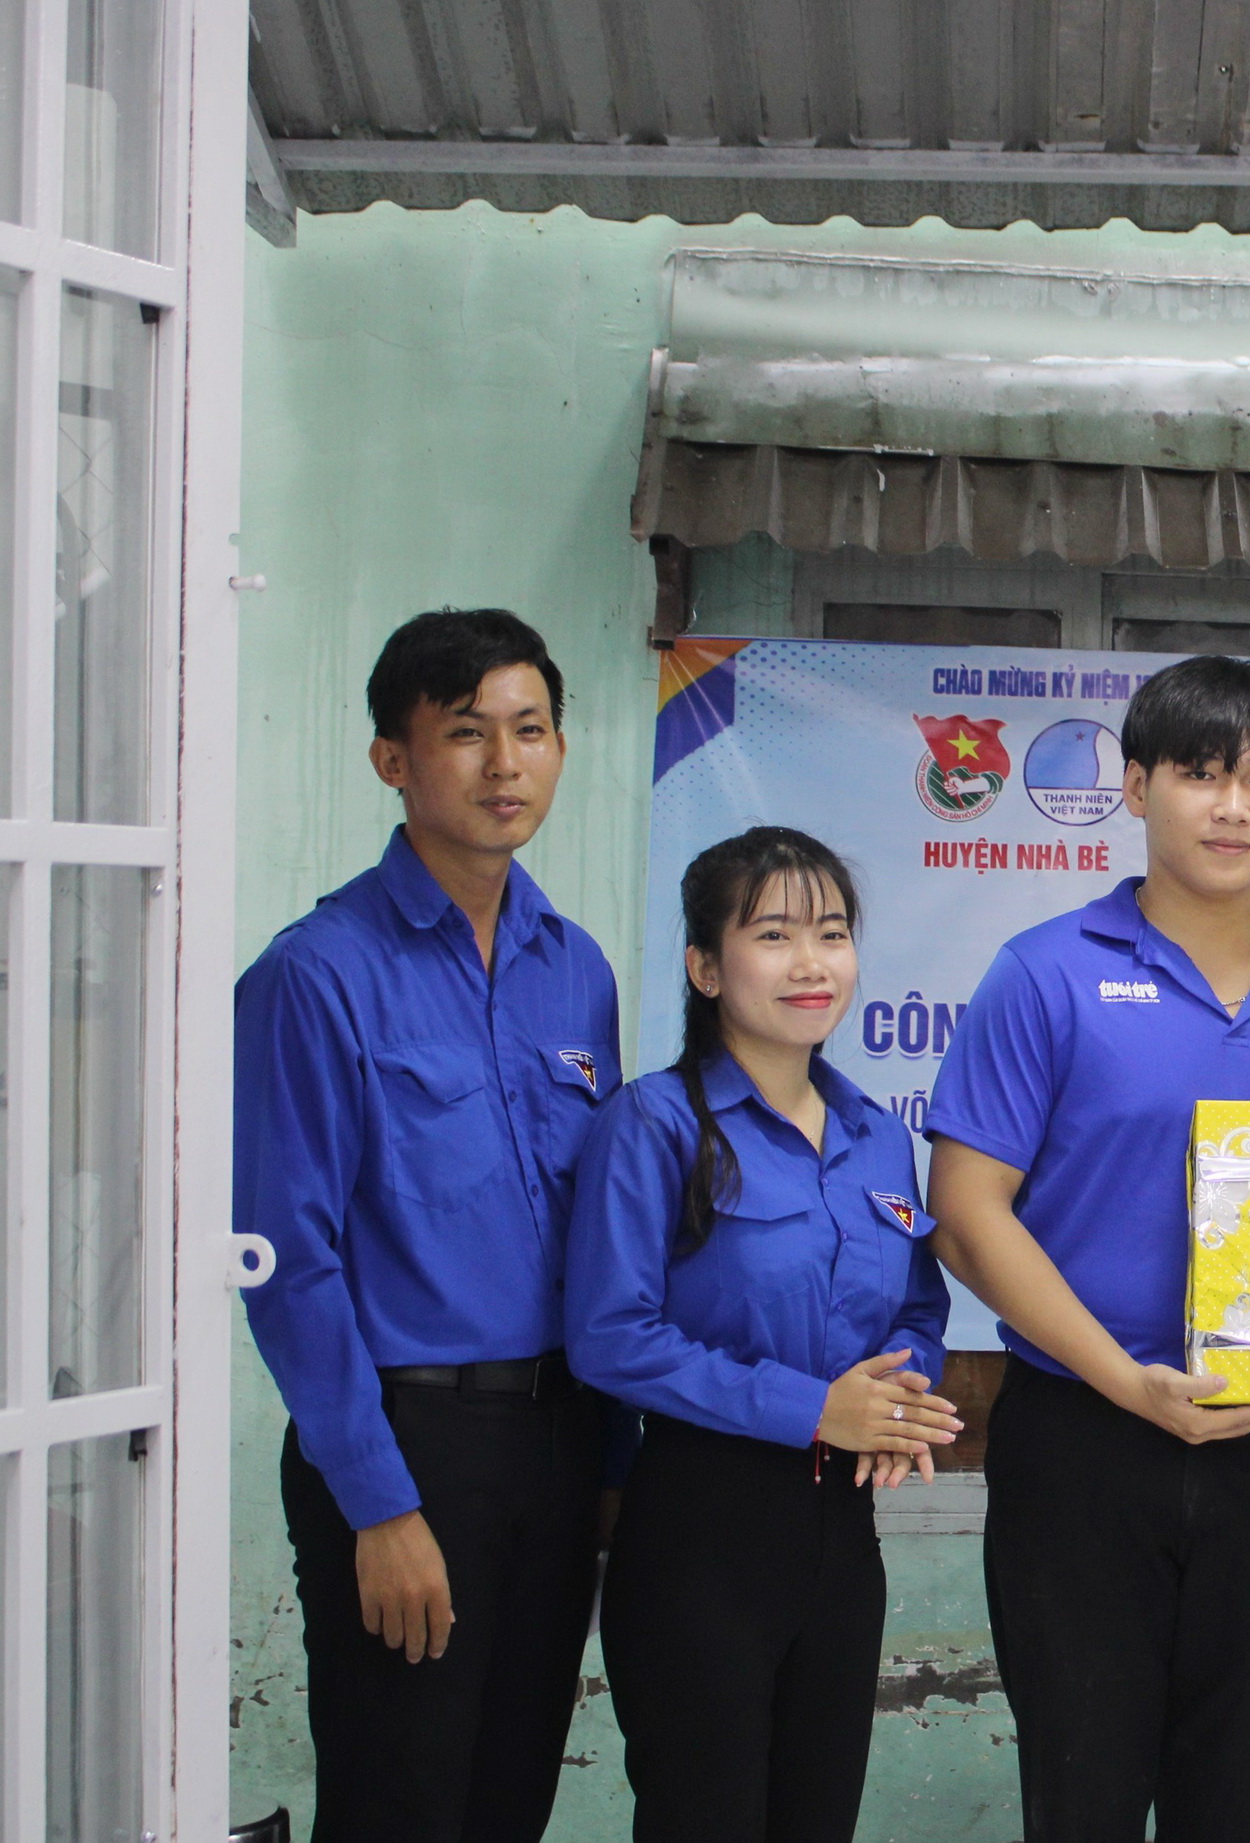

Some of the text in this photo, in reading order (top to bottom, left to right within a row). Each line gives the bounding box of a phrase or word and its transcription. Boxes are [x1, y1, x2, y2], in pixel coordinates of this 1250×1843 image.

[933, 664, 1130, 706] CHÀO MỪNG KỶ NIỆM
[1043, 793, 1112, 804] THANH NIÊN
[1050, 804, 1104, 816] VIỆT NAM
[924, 837, 1109, 875] HUYỆN NHÀ BÈ
[863, 991, 968, 1054] CÔN
